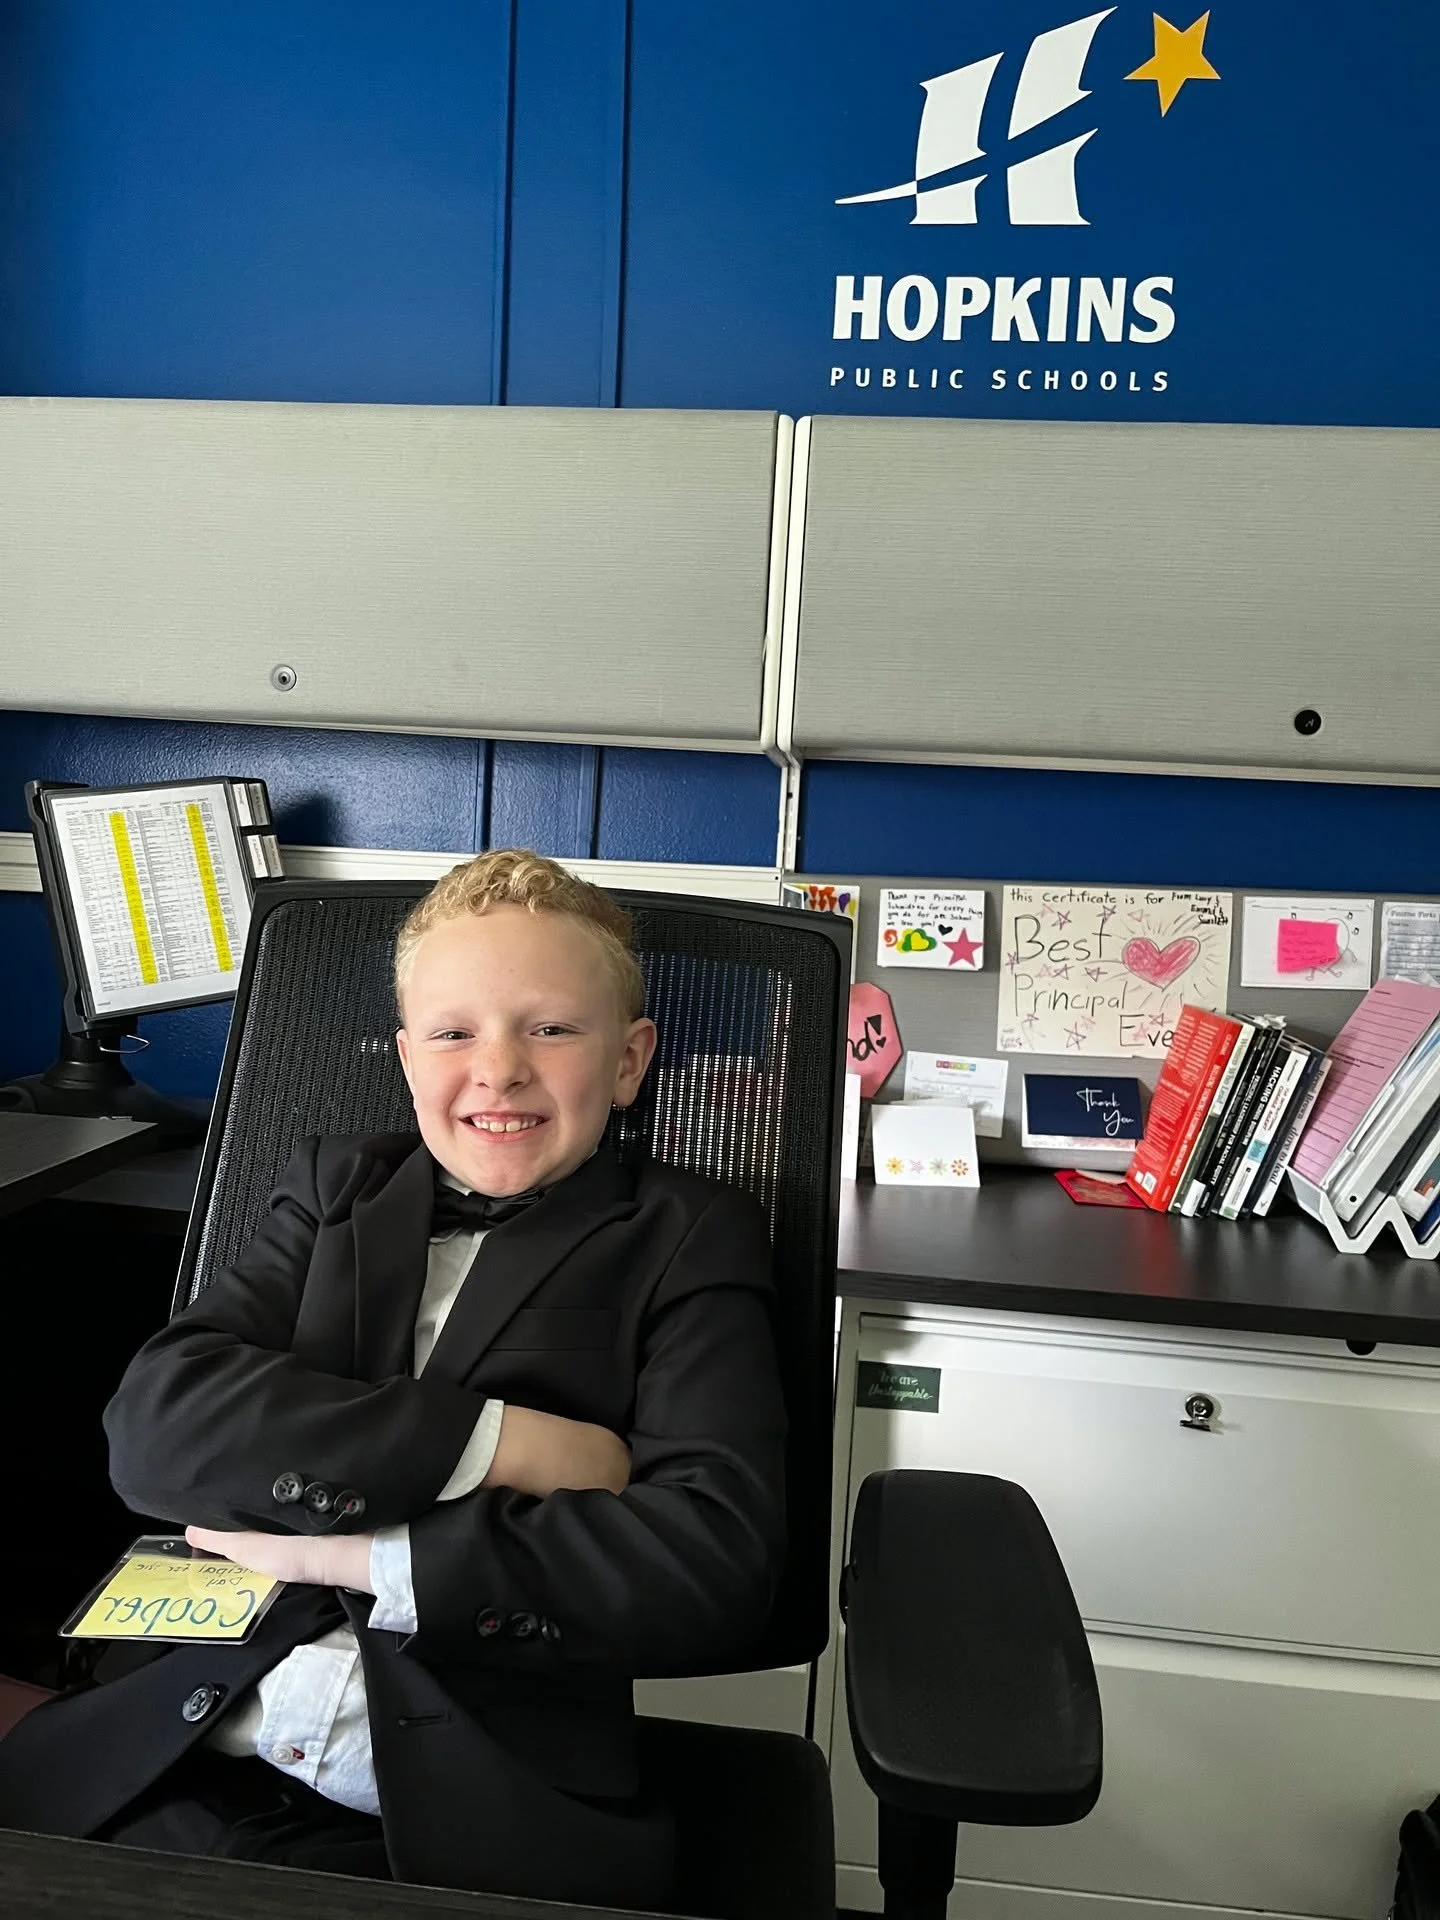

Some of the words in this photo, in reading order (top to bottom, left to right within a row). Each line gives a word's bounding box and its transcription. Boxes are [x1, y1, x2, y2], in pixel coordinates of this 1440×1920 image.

[833, 274, 1176, 344] HOPKINS
[830, 367, 964, 389] PUBLIC
[991, 369, 1169, 392] SCHOOLS
[1011, 888, 1033, 903] this
[1042, 889, 1117, 904] certificate
[1125, 895, 1135, 905] is
[1146, 893, 1165, 905] for
[1014, 914, 1112, 963] Best
[1014, 973, 1128, 1016] Principal
[1259, 1065, 1282, 1103] HACKING
[1076, 1087, 1120, 1112] Thank
[1103, 1109, 1134, 1137] You
[1283, 1126, 1300, 1151] dare
[1277, 1149, 1288, 1162] to
[1268, 1162, 1285, 1185] lead
